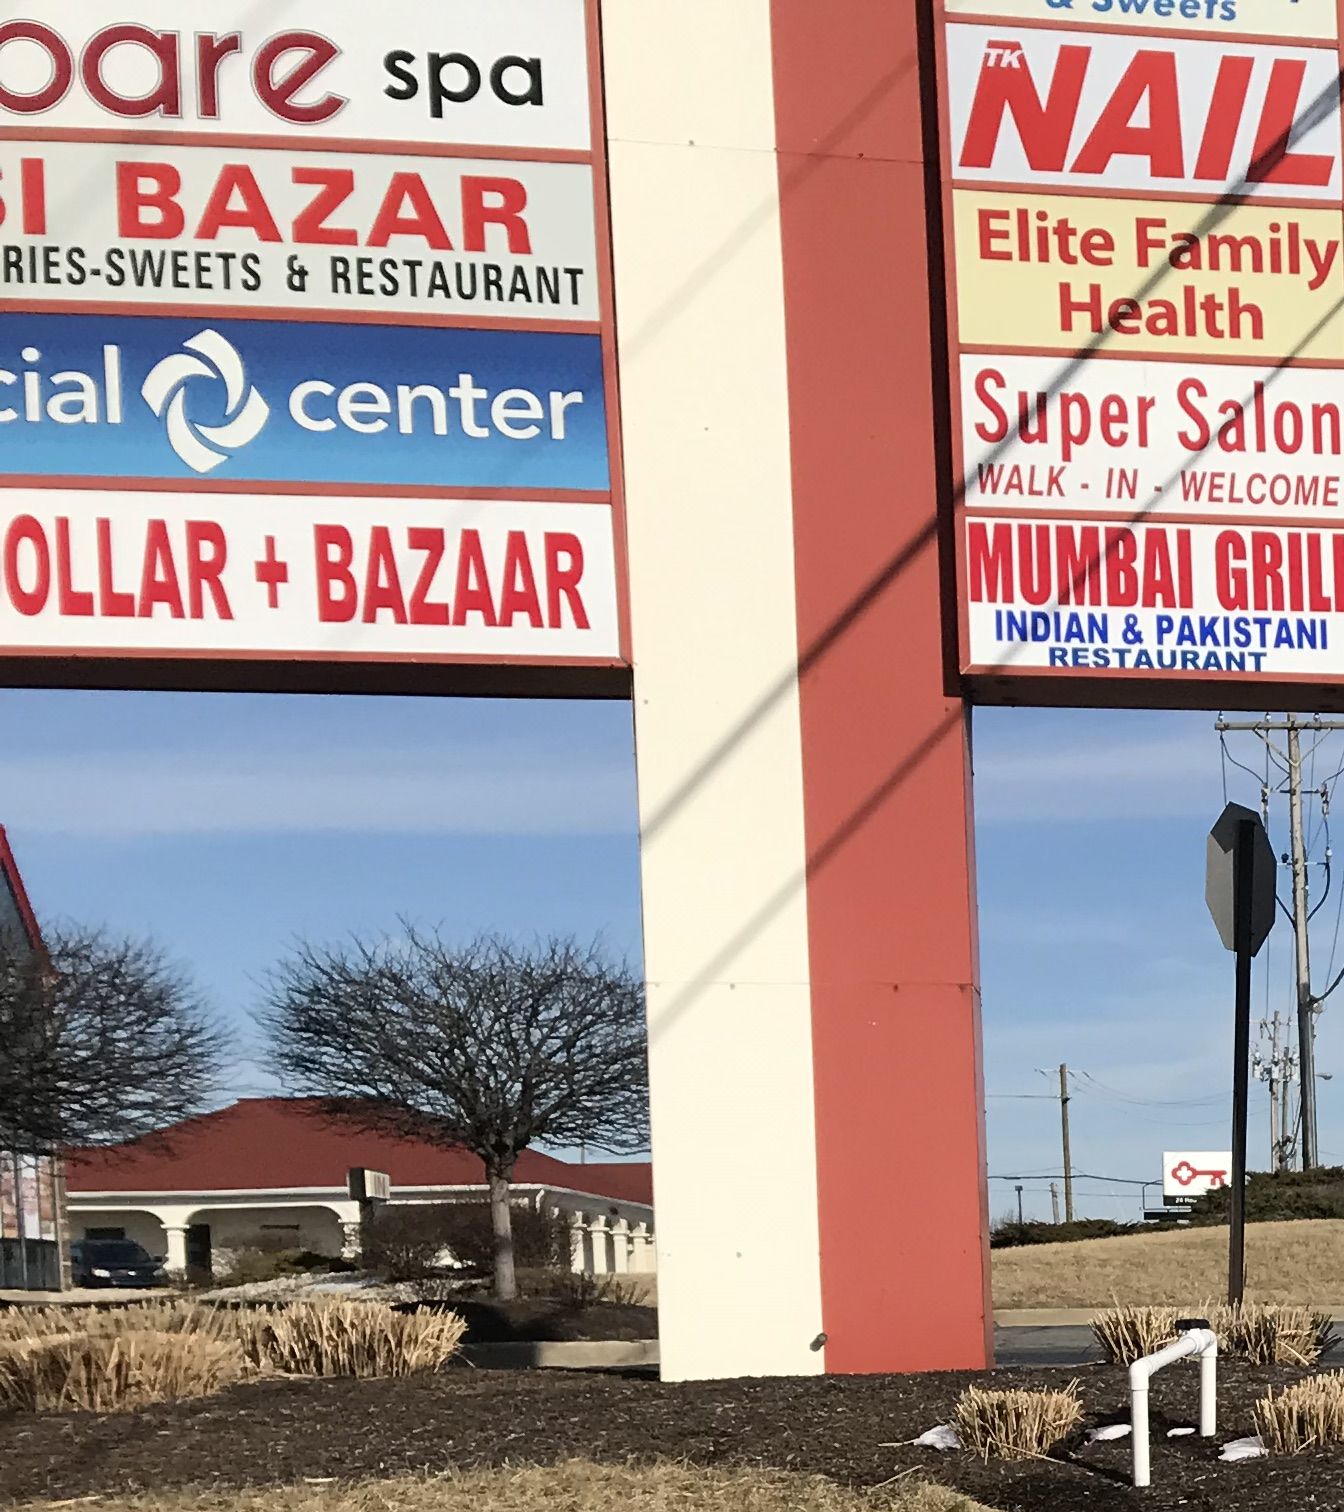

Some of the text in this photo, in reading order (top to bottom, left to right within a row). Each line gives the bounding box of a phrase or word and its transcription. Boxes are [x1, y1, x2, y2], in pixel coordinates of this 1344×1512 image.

[384, 48, 544, 118] spa
[985, 47, 1023, 68] TK
[959, 40, 1335, 186] NAIL
[0, 157, 533, 254] I BAZAR
[3, 245, 584, 305] RIES-SWEETS & RESTAURANT
[977, 208, 1340, 290] Elite Family
[1059, 283, 1264, 340] Health
[288, 372, 584, 440] center
[974, 367, 1341, 462] Super Salon
[978, 463, 1066, 498] WALK
[1106, 468, 1139, 499] IN
[1180, 470, 1340, 506] WELCOME
[255, 535, 288, 608] +
[313, 523, 591, 630] BAZAAR
[967, 522, 1194, 609] MUMBAI
[995, 610, 1328, 649] INDIAN & PAKISTANI
[1049, 647, 1267, 672] RESTAURANT
